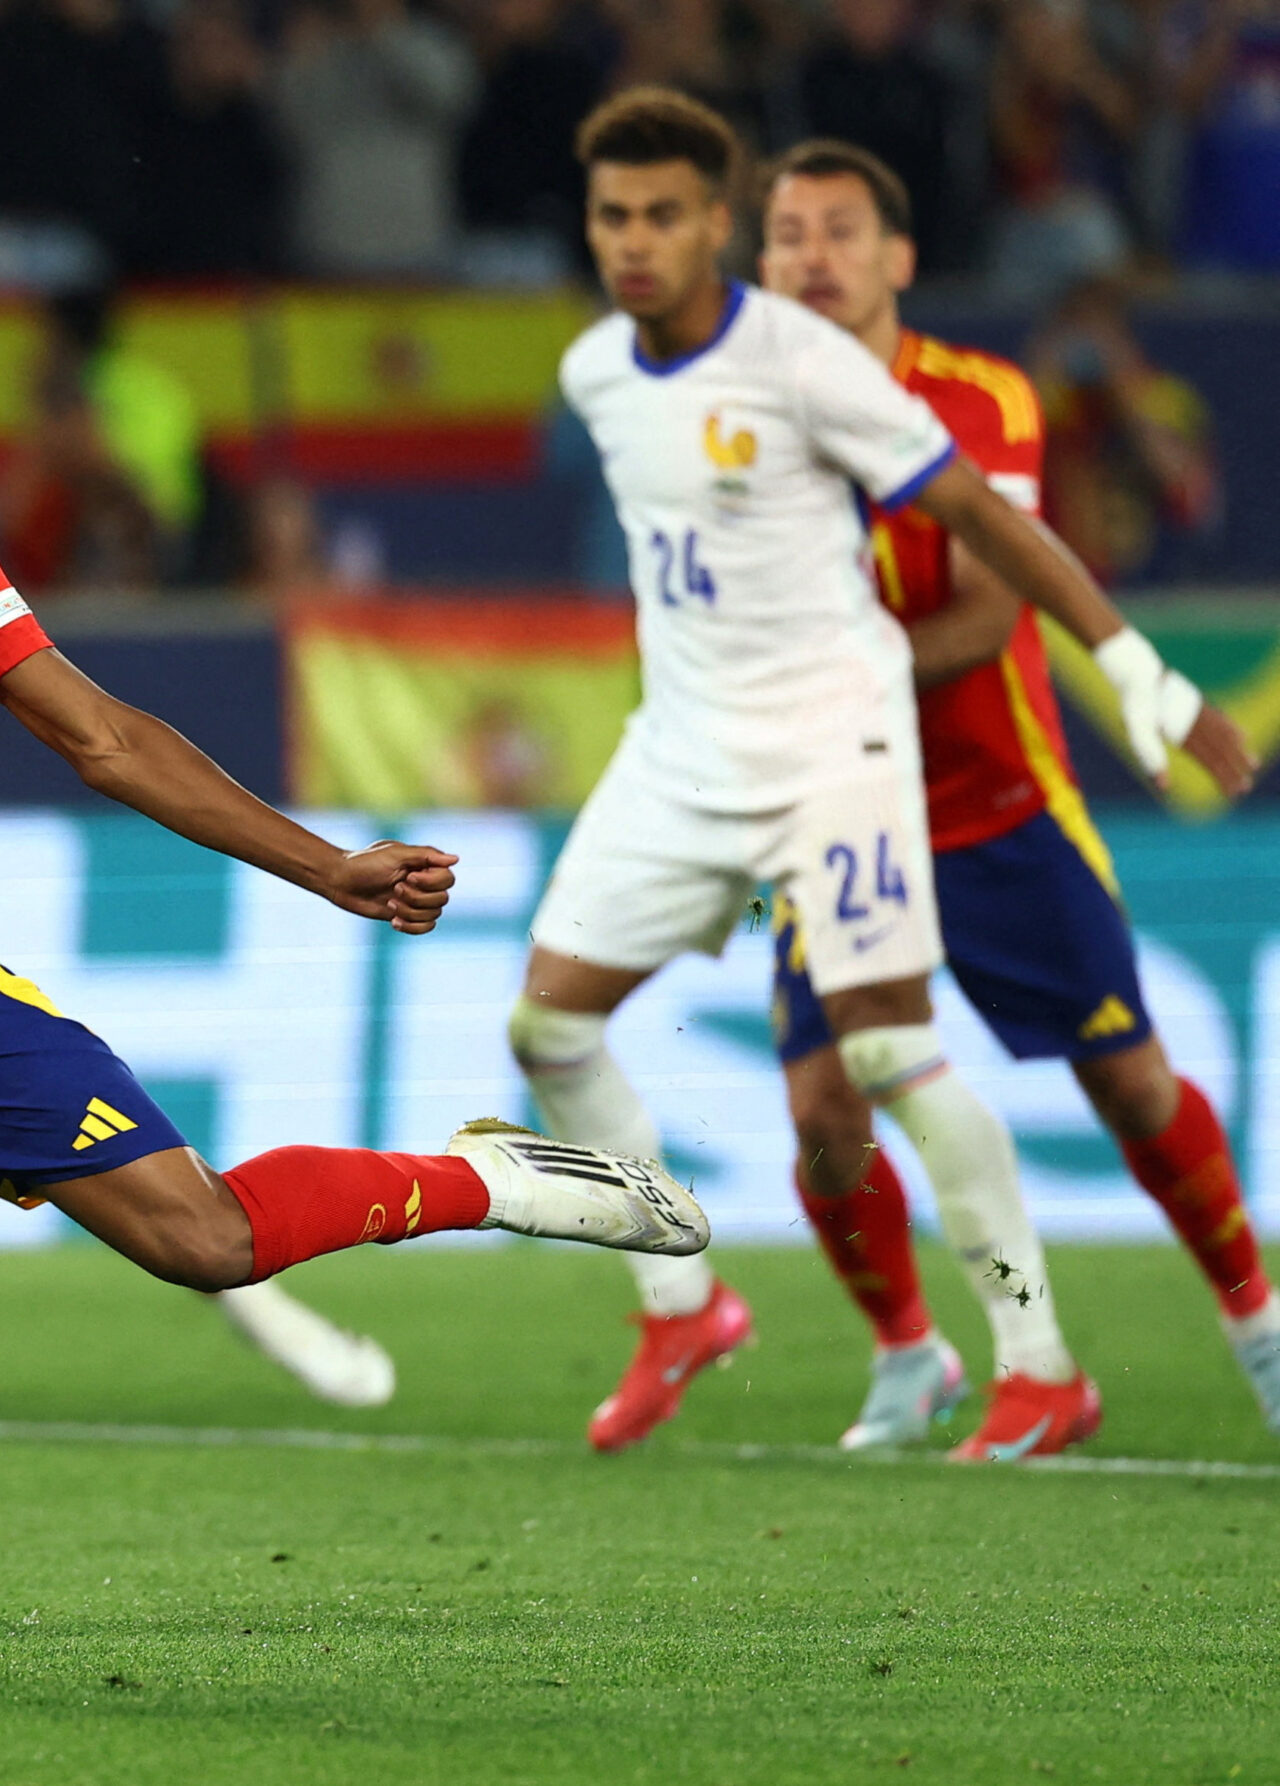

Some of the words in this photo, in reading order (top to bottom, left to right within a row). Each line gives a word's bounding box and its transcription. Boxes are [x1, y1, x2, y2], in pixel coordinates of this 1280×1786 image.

[651, 529, 716, 606] 24
[826, 831, 908, 922] 24
[616, 1160, 696, 1232] F50
